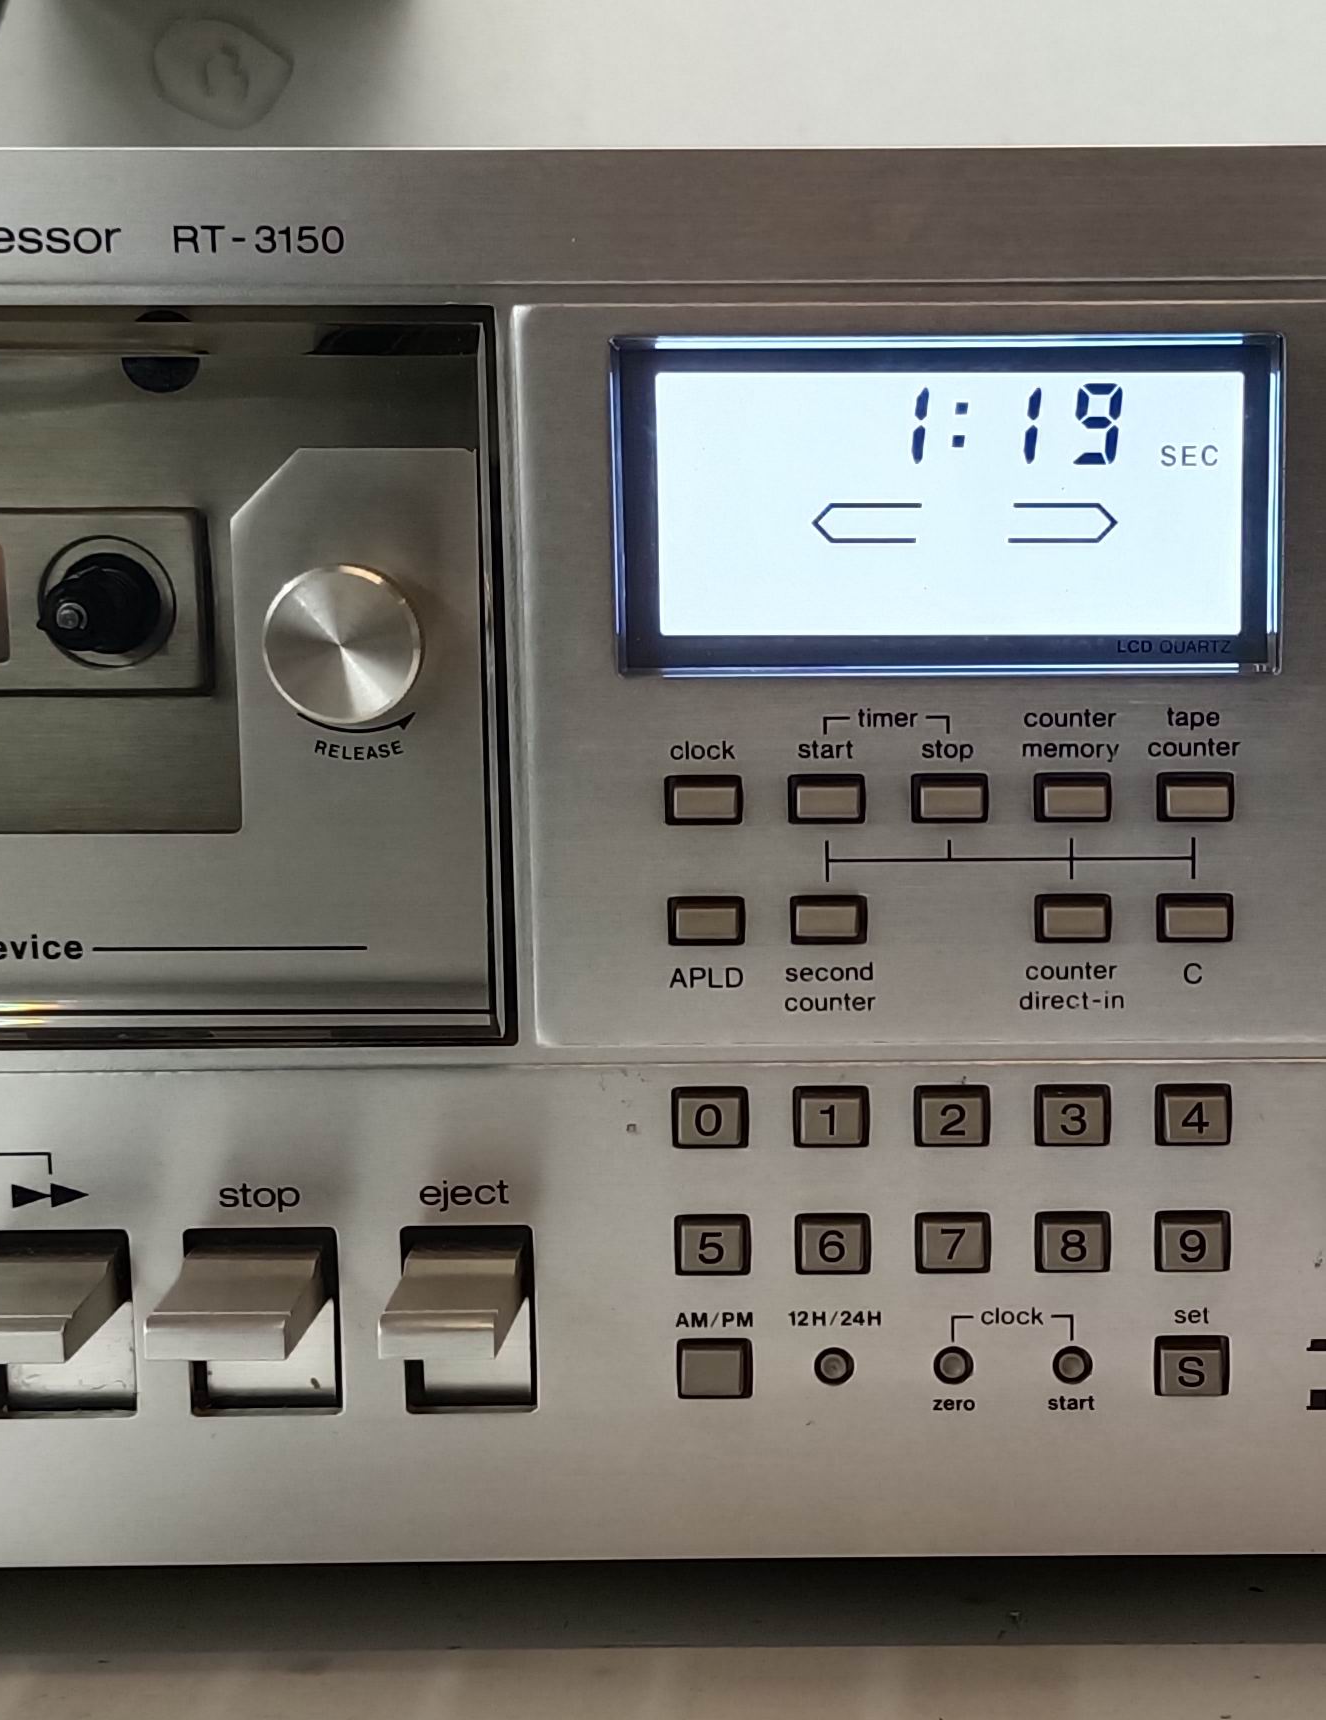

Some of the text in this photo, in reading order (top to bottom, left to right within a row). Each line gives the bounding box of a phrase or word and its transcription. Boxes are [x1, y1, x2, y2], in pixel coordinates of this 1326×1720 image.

[173, 225, 345, 255] RT-3150
[911, 382, 1219, 467] 1:19 SEC
[1117, 639, 1231, 654] LCD QUARTZ
[857, 707, 919, 728] timer
[1023, 708, 1117, 728] counter
[1166, 706, 1220, 731] tape
[314, 739, 404, 761] RELEASE
[670, 740, 736, 761] clock
[797, 740, 854, 760] start
[921, 739, 974, 763] stop
[1022, 742, 1120, 763] memory
[1147, 737, 1241, 758] counter
[669, 966, 744, 989] APLD
[785, 961, 874, 983] second
[1025, 961, 1118, 981] counter
[1183, 962, 1203, 985] C
[784, 992, 876, 1012] counter
[1019, 990, 1125, 1011] direct-in
[694, 1103, 723, 1137] 0
[819, 1104, 835, 1136] 1
[939, 1103, 966, 1136] 2
[1060, 1103, 1087, 1136] 3
[1181, 1101, 1210, 1135] 4
[219, 1182, 301, 1213] stop
[419, 1179, 510, 1213] eject
[698, 1231, 724, 1265] 5
[818, 1229, 846, 1263] 6
[940, 1228, 966, 1260] 7
[1060, 1229, 1087, 1263] 8
[1179, 1229, 1207, 1263] 9
[675, 1311, 754, 1328] AM/PM
[788, 1310, 882, 1327] 12H/24H
[980, 1306, 1044, 1326] clock
[1174, 1307, 1209, 1325] set
[1177, 1356, 1205, 1388] S
[932, 1398, 976, 1412] zero
[1047, 1395, 1095, 1411] start
